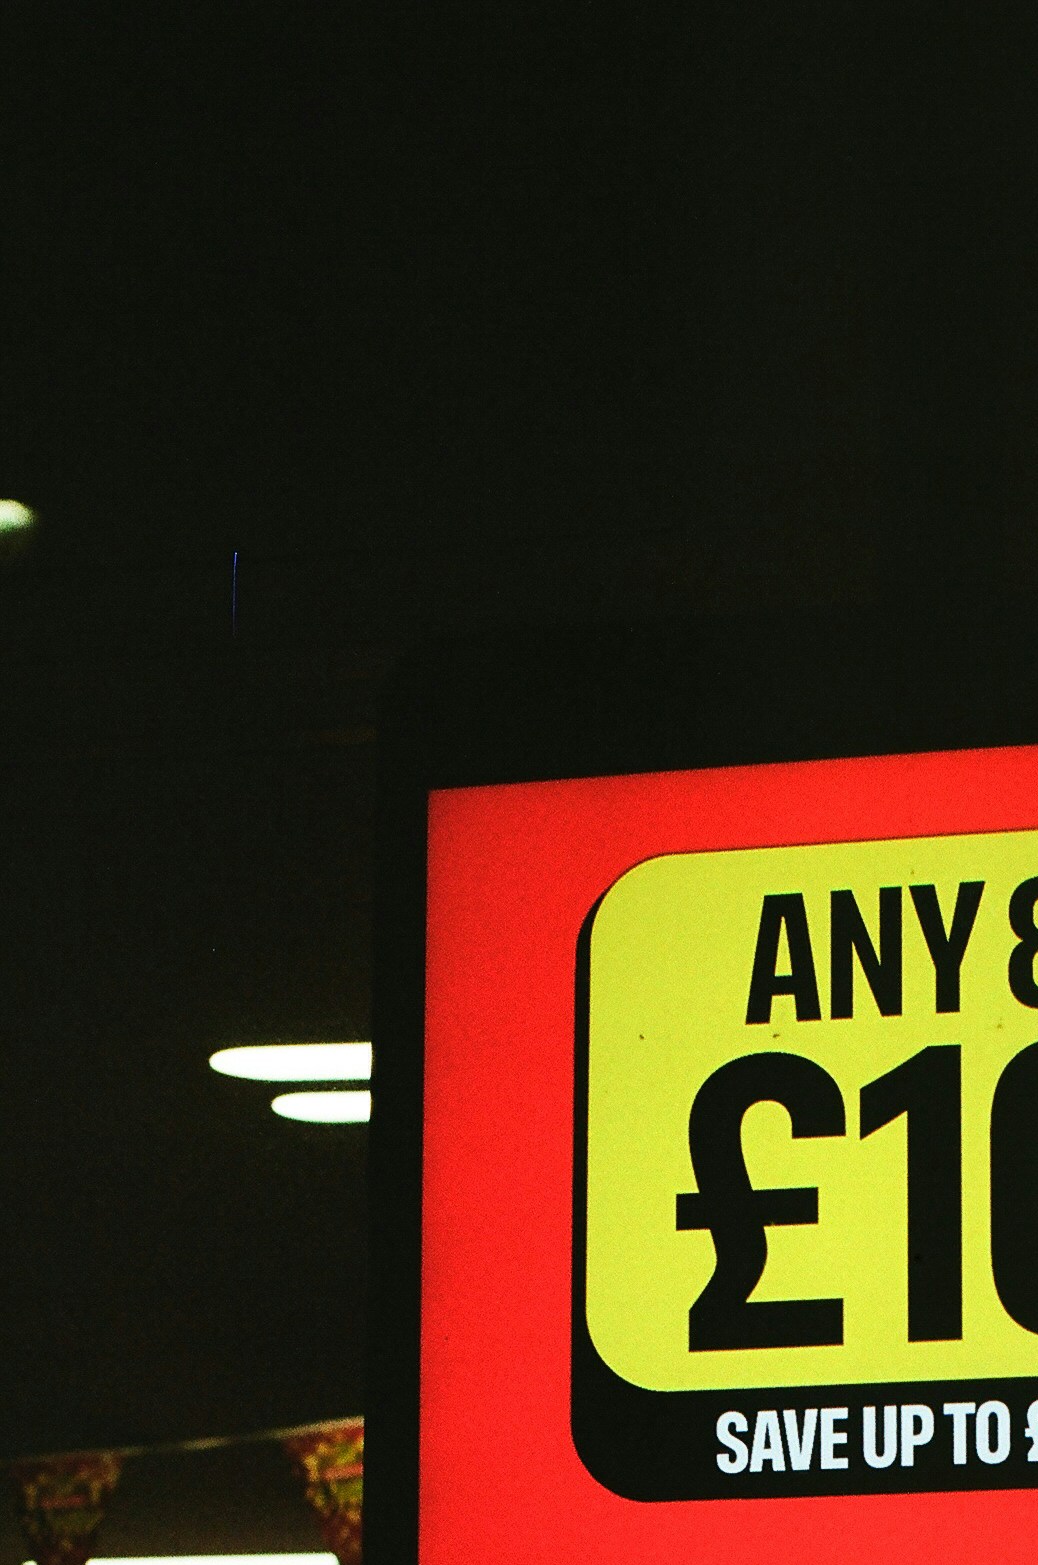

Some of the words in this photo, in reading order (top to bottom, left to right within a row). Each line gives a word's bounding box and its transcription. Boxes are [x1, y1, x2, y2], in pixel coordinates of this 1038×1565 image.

[746, 880, 985, 1024] ANY
[716, 1407, 848, 1473] SAVE
[862, 1403, 934, 1468] UP
[943, 1399, 1010, 1464] TO
